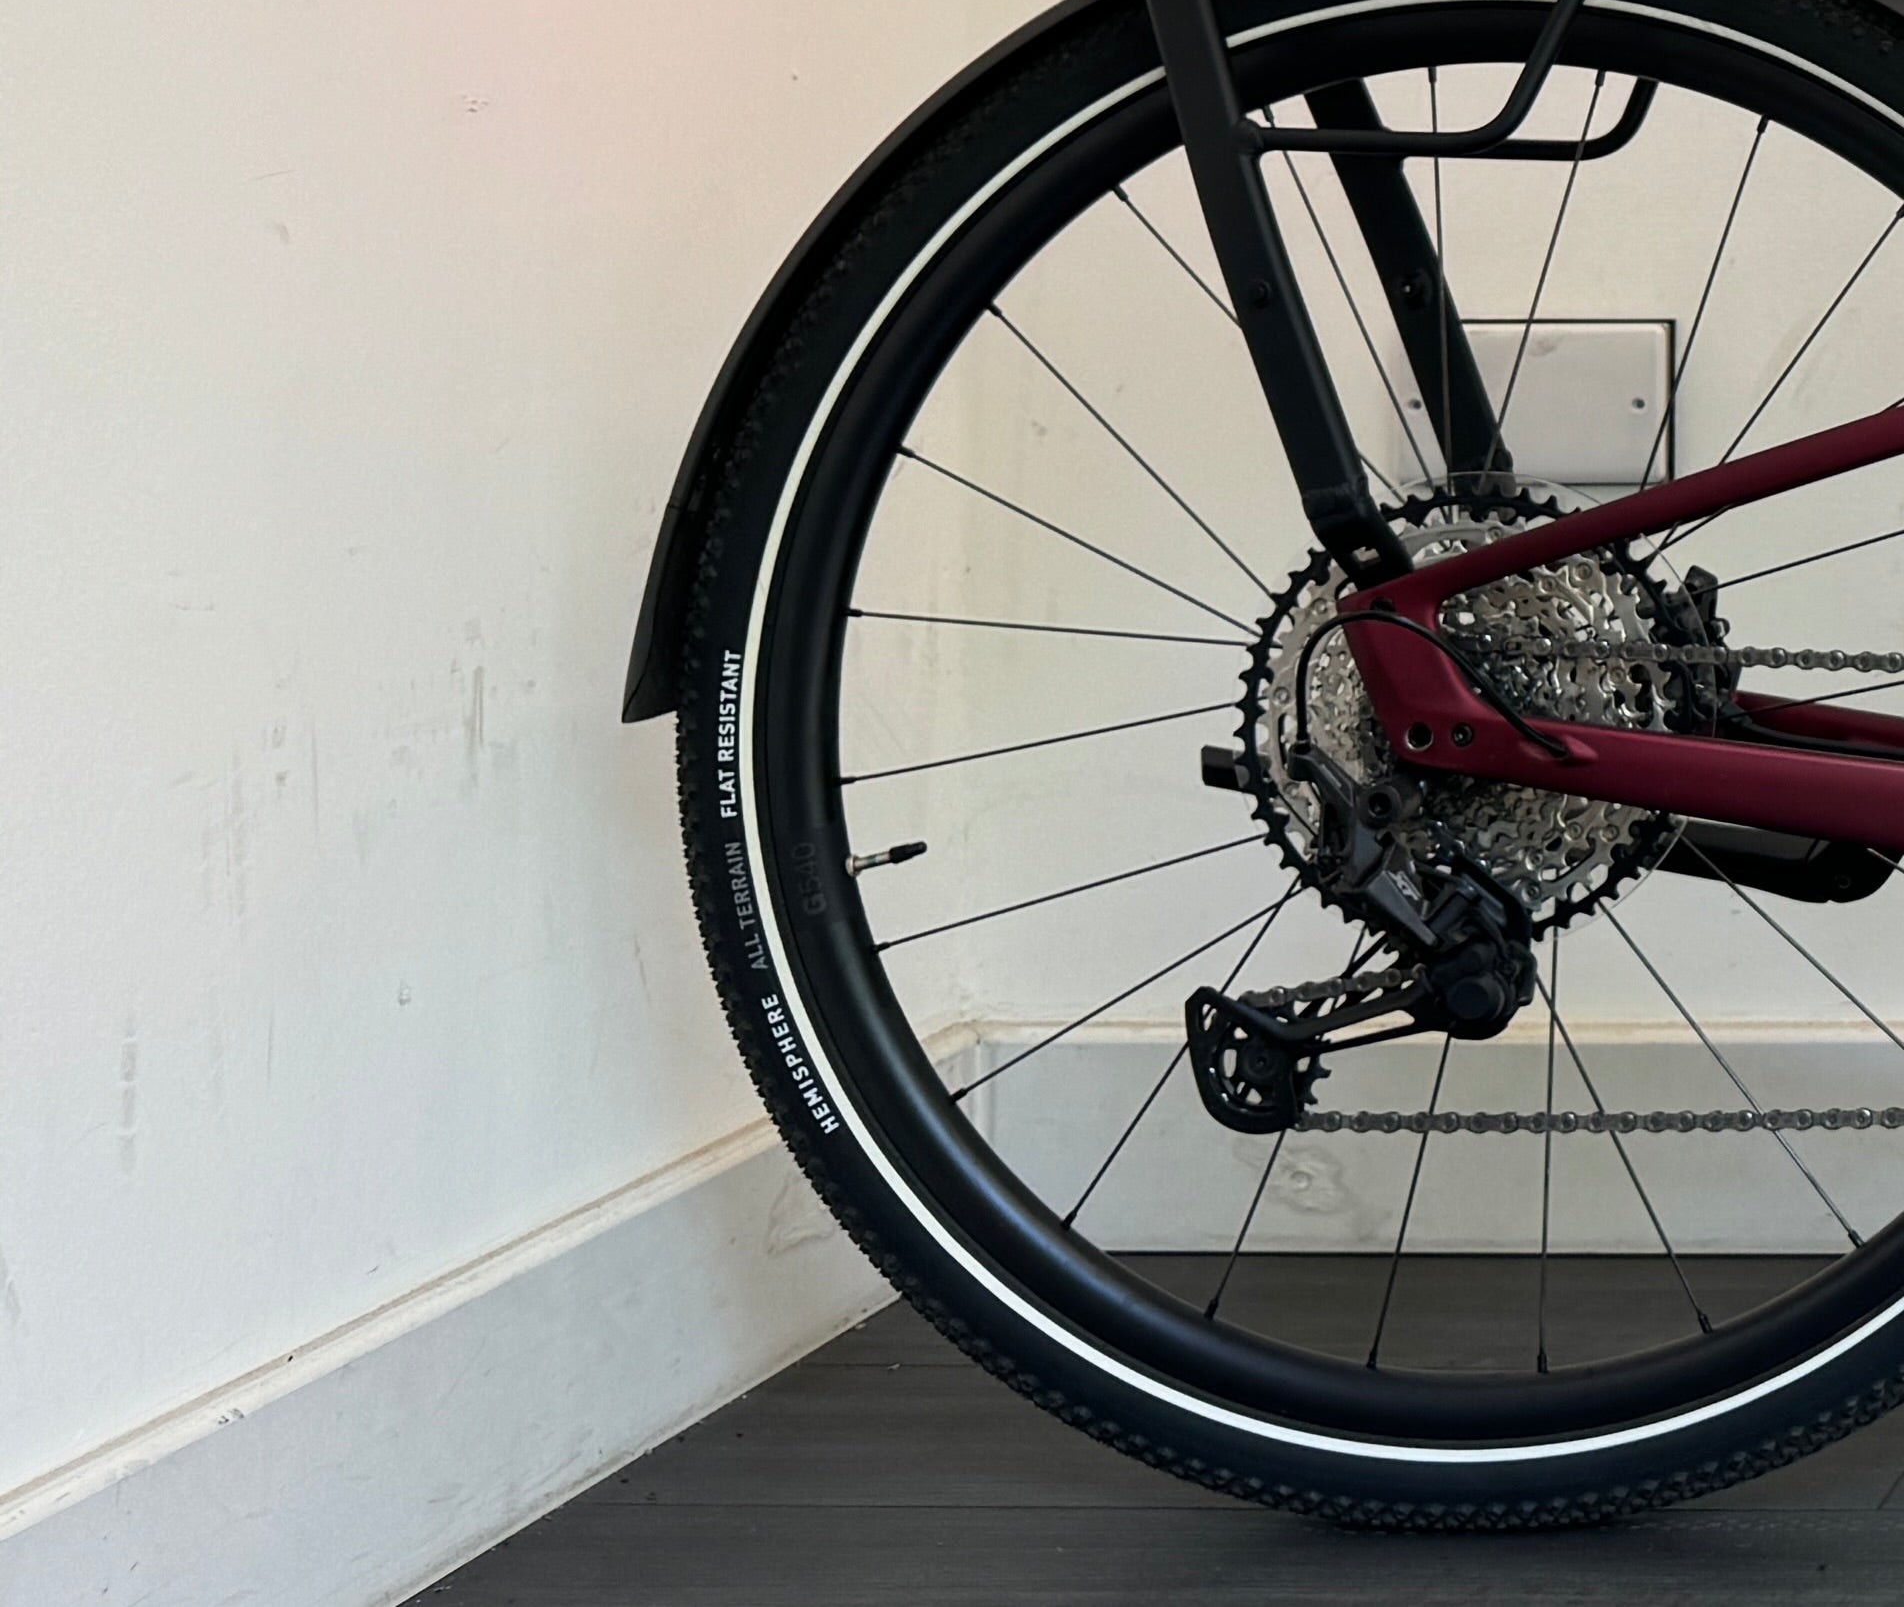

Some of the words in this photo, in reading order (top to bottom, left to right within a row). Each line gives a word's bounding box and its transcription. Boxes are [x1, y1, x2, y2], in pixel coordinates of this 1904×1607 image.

[717, 649, 742, 768] RESISTANT
[718, 770, 738, 818] FLAT
[724, 841, 756, 931] TERRAIN
[744, 932, 767, 970] ALL
[761, 992, 840, 1134] HEMISPHERE
